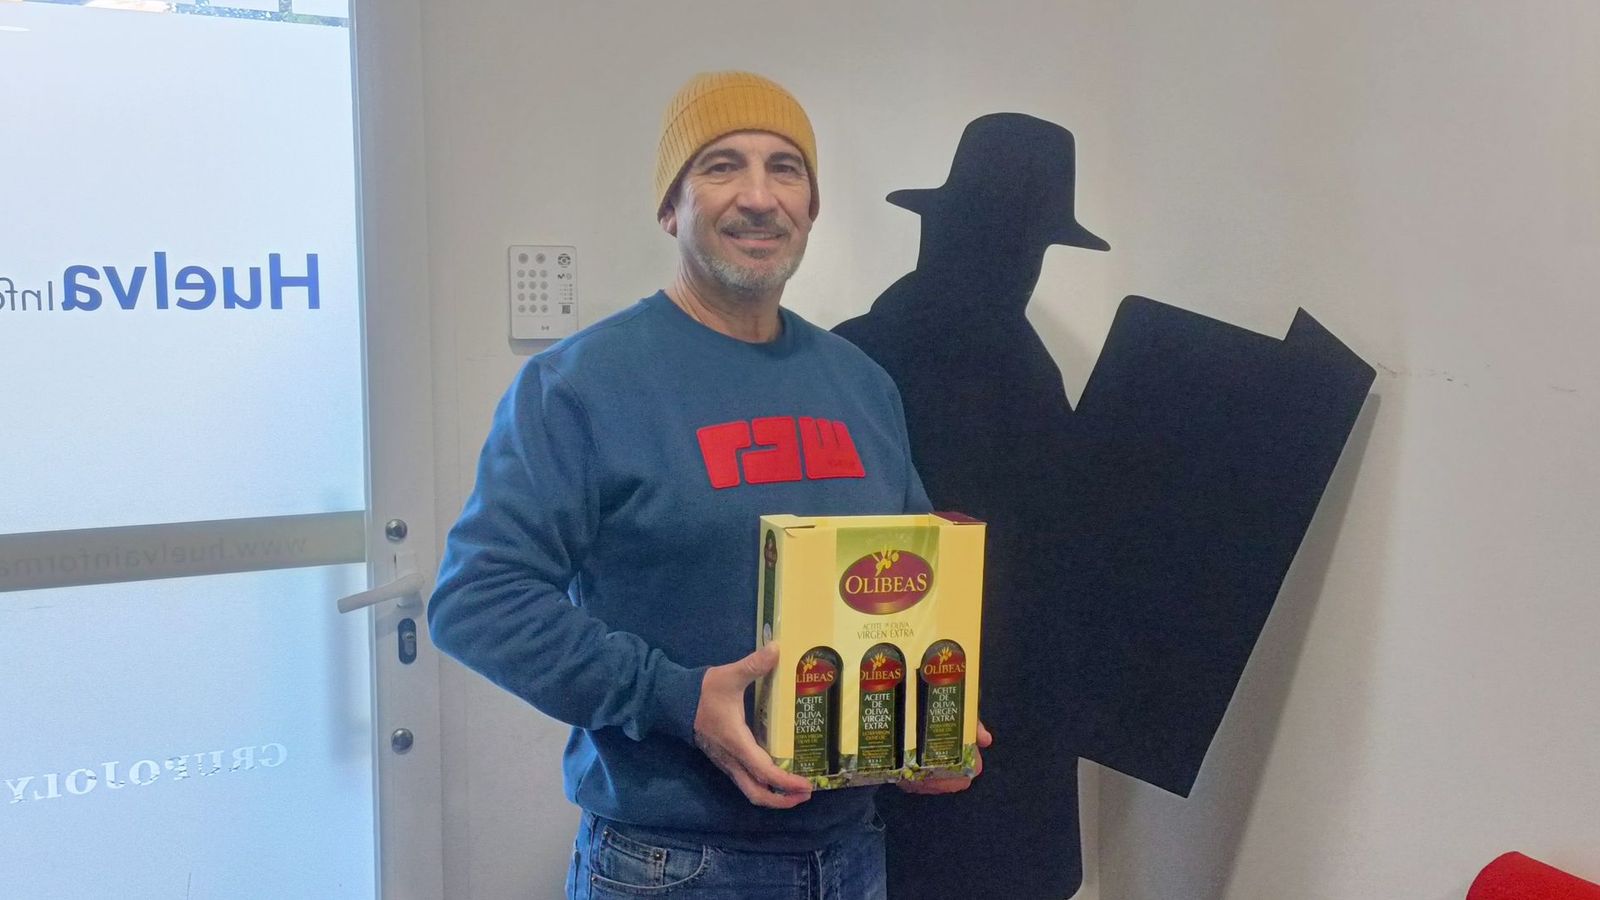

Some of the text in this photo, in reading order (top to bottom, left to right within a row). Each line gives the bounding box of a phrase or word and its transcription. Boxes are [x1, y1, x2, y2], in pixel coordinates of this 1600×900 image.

[857, 628, 915, 640] VIRGEN EXTRA
[932, 687, 957, 695] ACEITE
[796, 696, 823, 704] ACEITE
[864, 693, 890, 701] ACEITE
[940, 693, 950, 701] DE
[803, 703, 815, 712] DE
[872, 700, 882, 708] DE
[796, 711, 822, 719] OLIVA
[865, 707, 889, 715] OLIVA
[929, 708, 958, 716] VIRGEN
[794, 718, 825, 727] VIRGEN
[862, 714, 892, 723] VIRGEN
[932, 715, 956, 723] EXTRA
[796, 725, 822, 734] EXTRA
[864, 721, 889, 730] EXTRA
